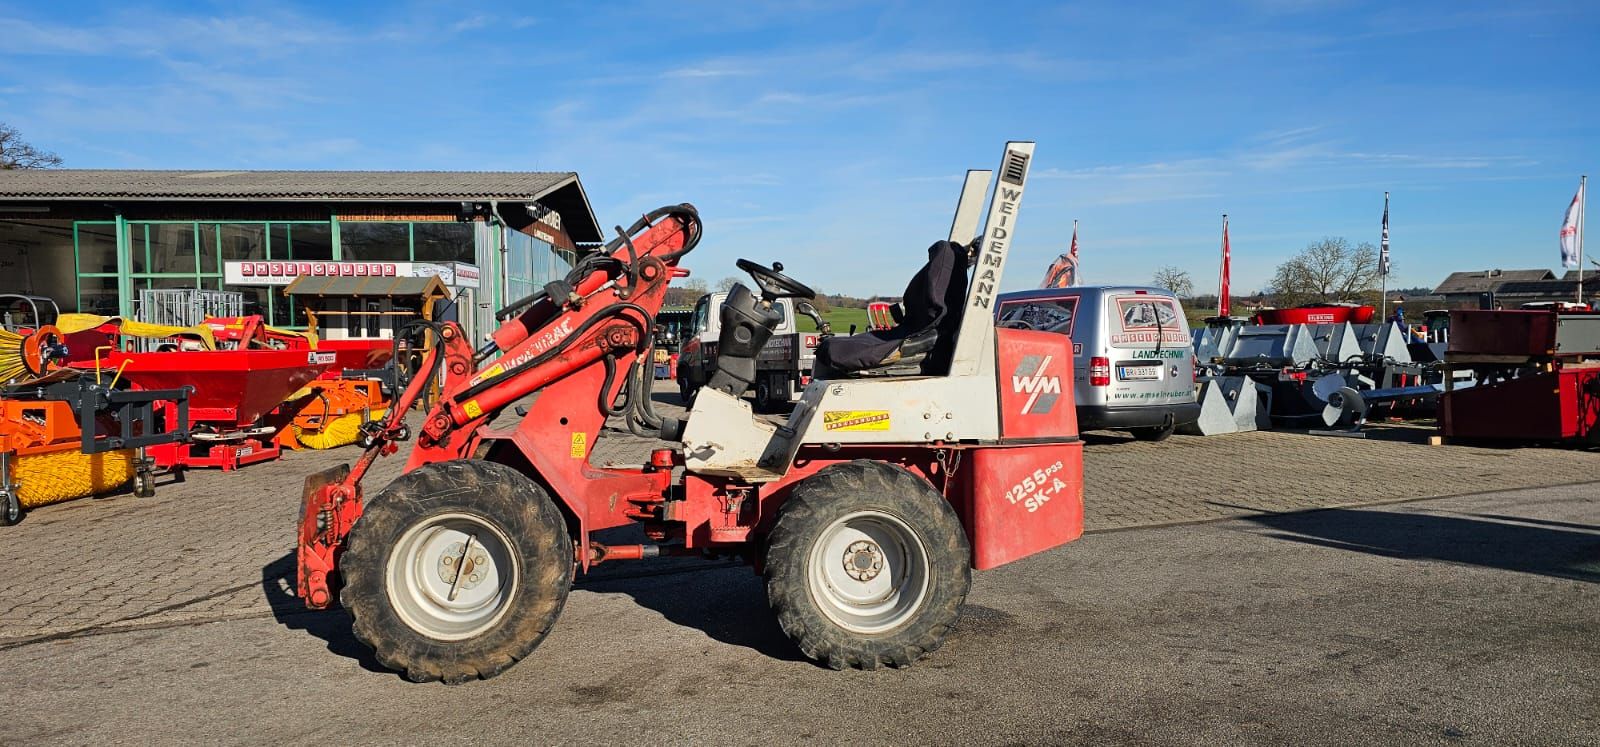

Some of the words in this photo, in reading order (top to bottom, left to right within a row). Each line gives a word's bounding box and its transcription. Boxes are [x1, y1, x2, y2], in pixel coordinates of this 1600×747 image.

[974, 187, 1021, 309] WEIDEMANN
[242, 263, 395, 276] AMSELGRUBER
[1132, 350, 1185, 359] LANDTECHNIK
[1024, 478, 1067, 513] SK-A
